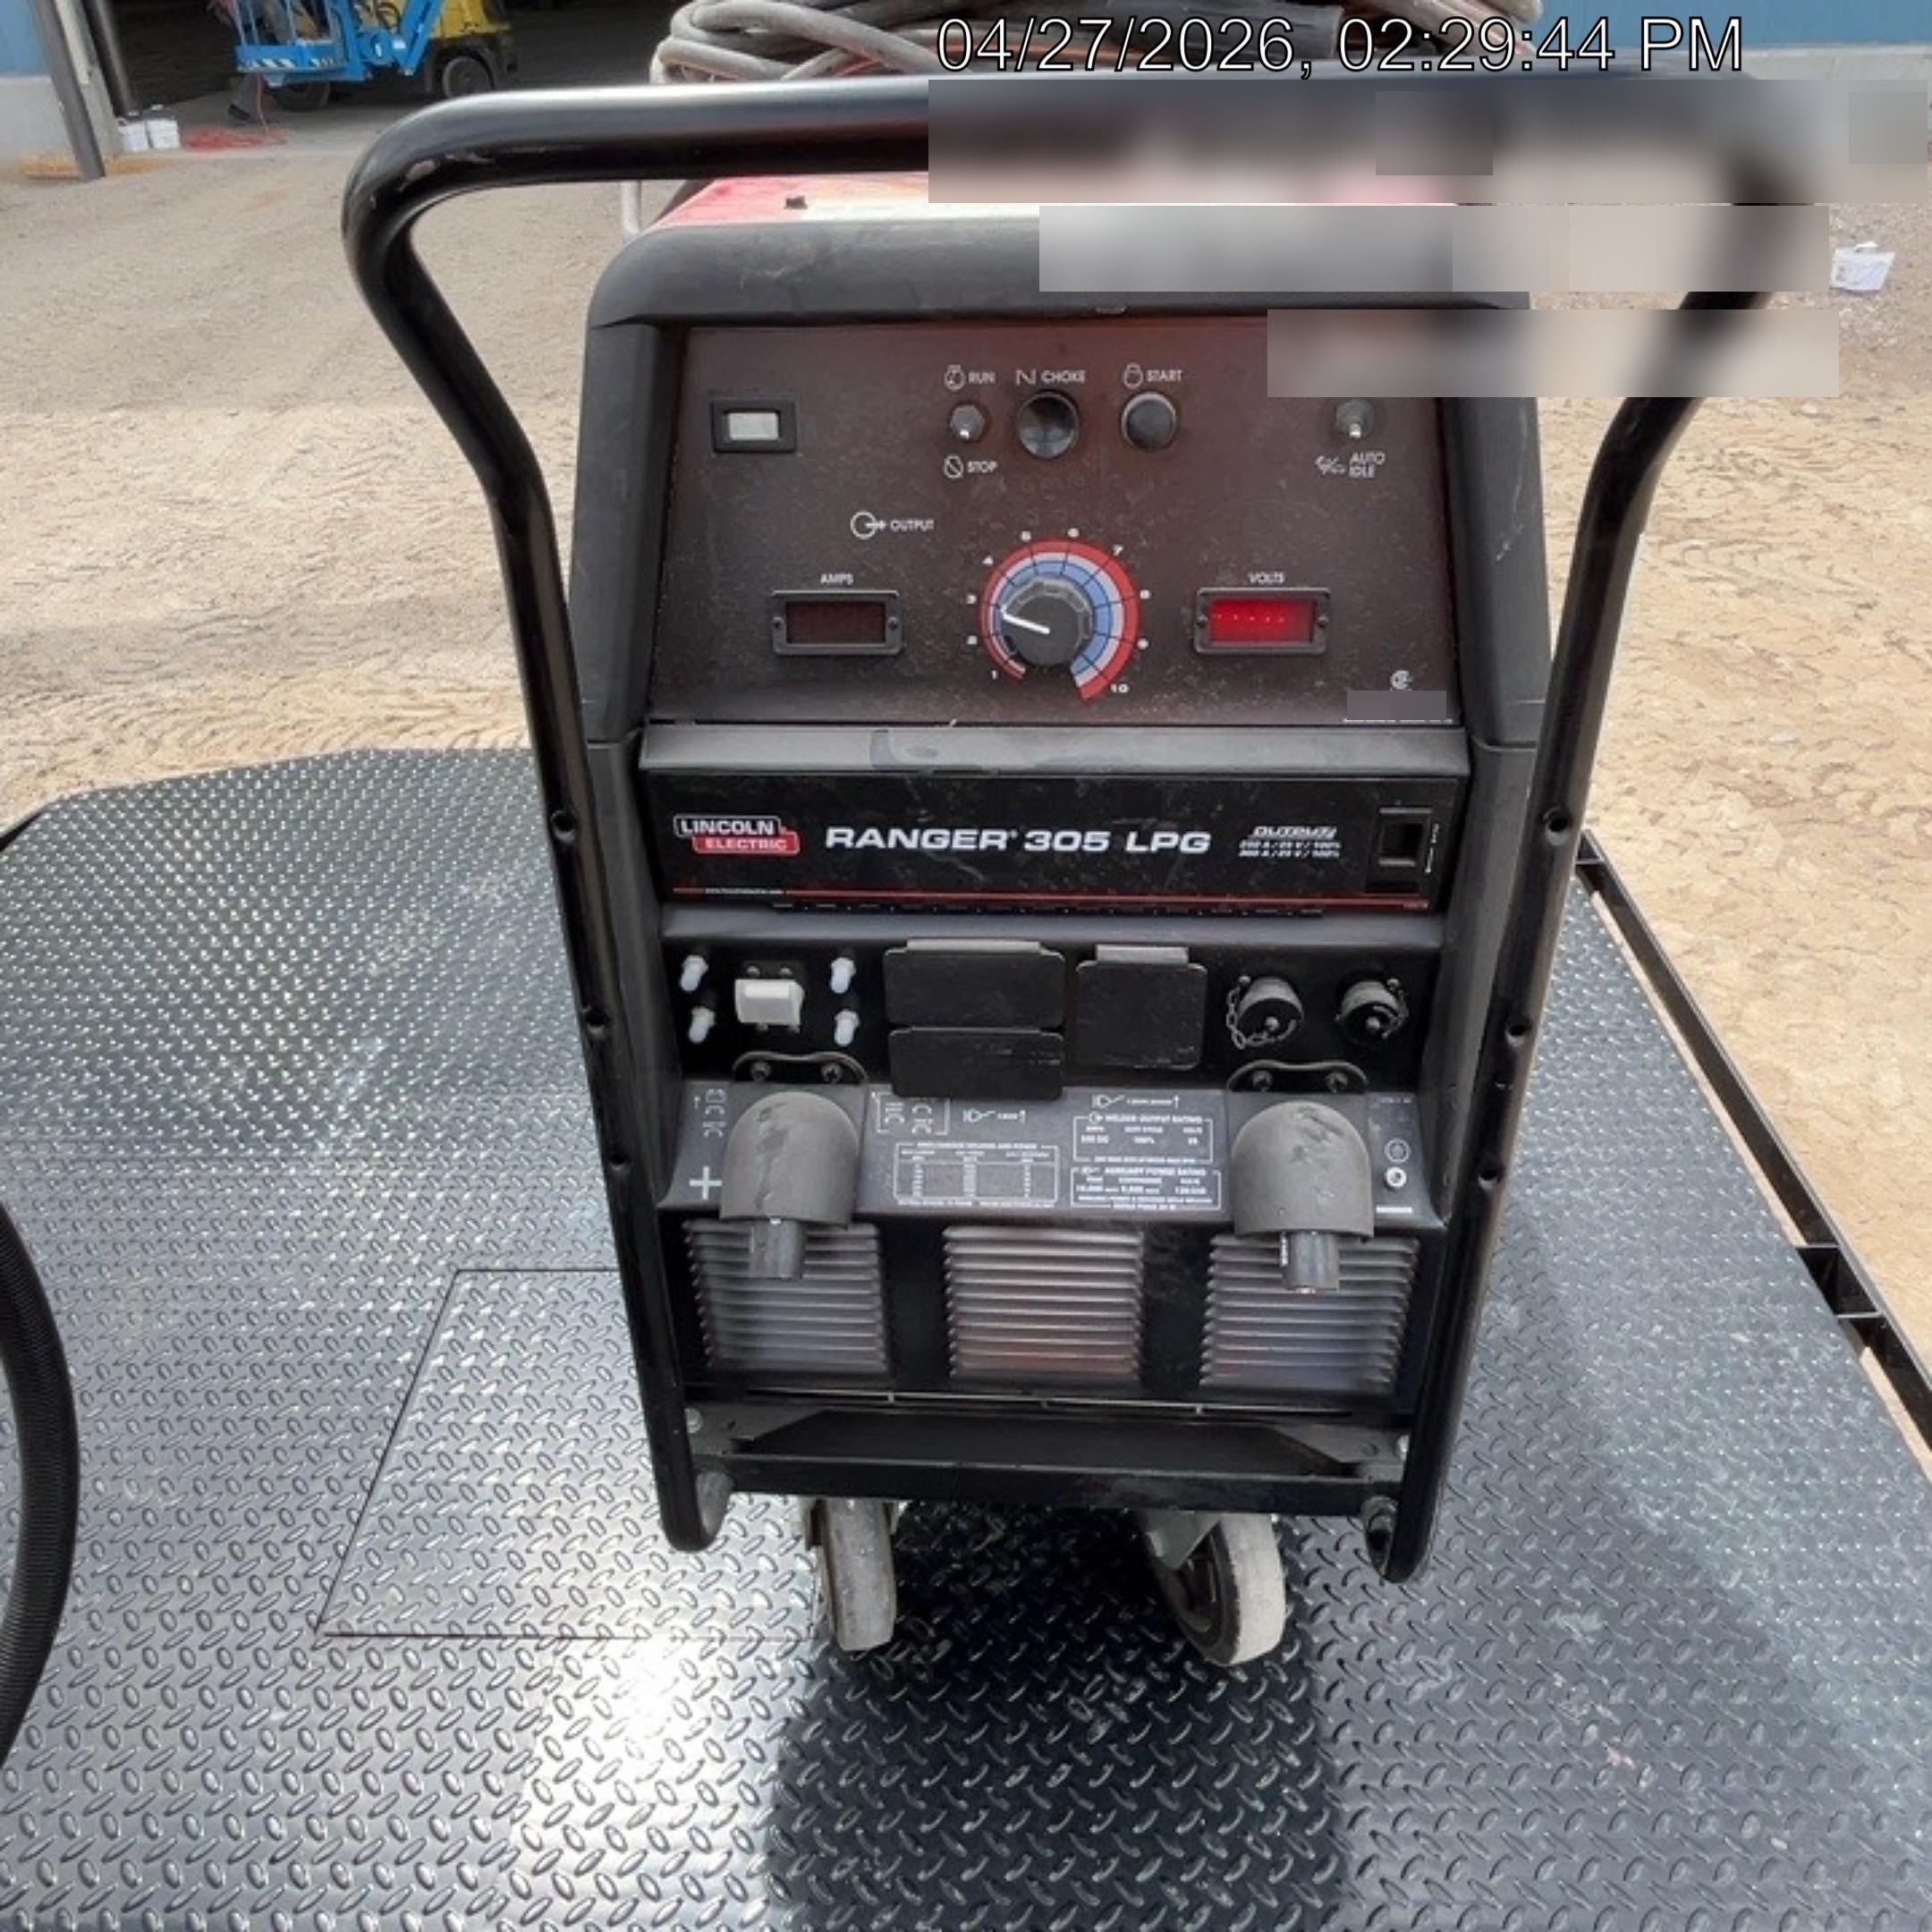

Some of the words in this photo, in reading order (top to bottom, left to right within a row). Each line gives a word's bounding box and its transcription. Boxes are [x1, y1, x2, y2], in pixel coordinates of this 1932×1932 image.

[968, 372, 996, 385] RUN
[1040, 369, 1086, 384] CHOKE
[1147, 369, 1182, 382] START
[1350, 453, 1385, 465] AUTO
[967, 461, 997, 473] STOP
[1350, 465, 1374, 478] IDLE
[889, 519, 935, 532] OUTPUT
[820, 572, 854, 585] AMPS
[681, 819, 775, 835] LINCOLN
[706, 838, 786, 852] ELECTRIC
[1024, 831, 1110, 852] 305
[1126, 832, 1210, 852] LPG
